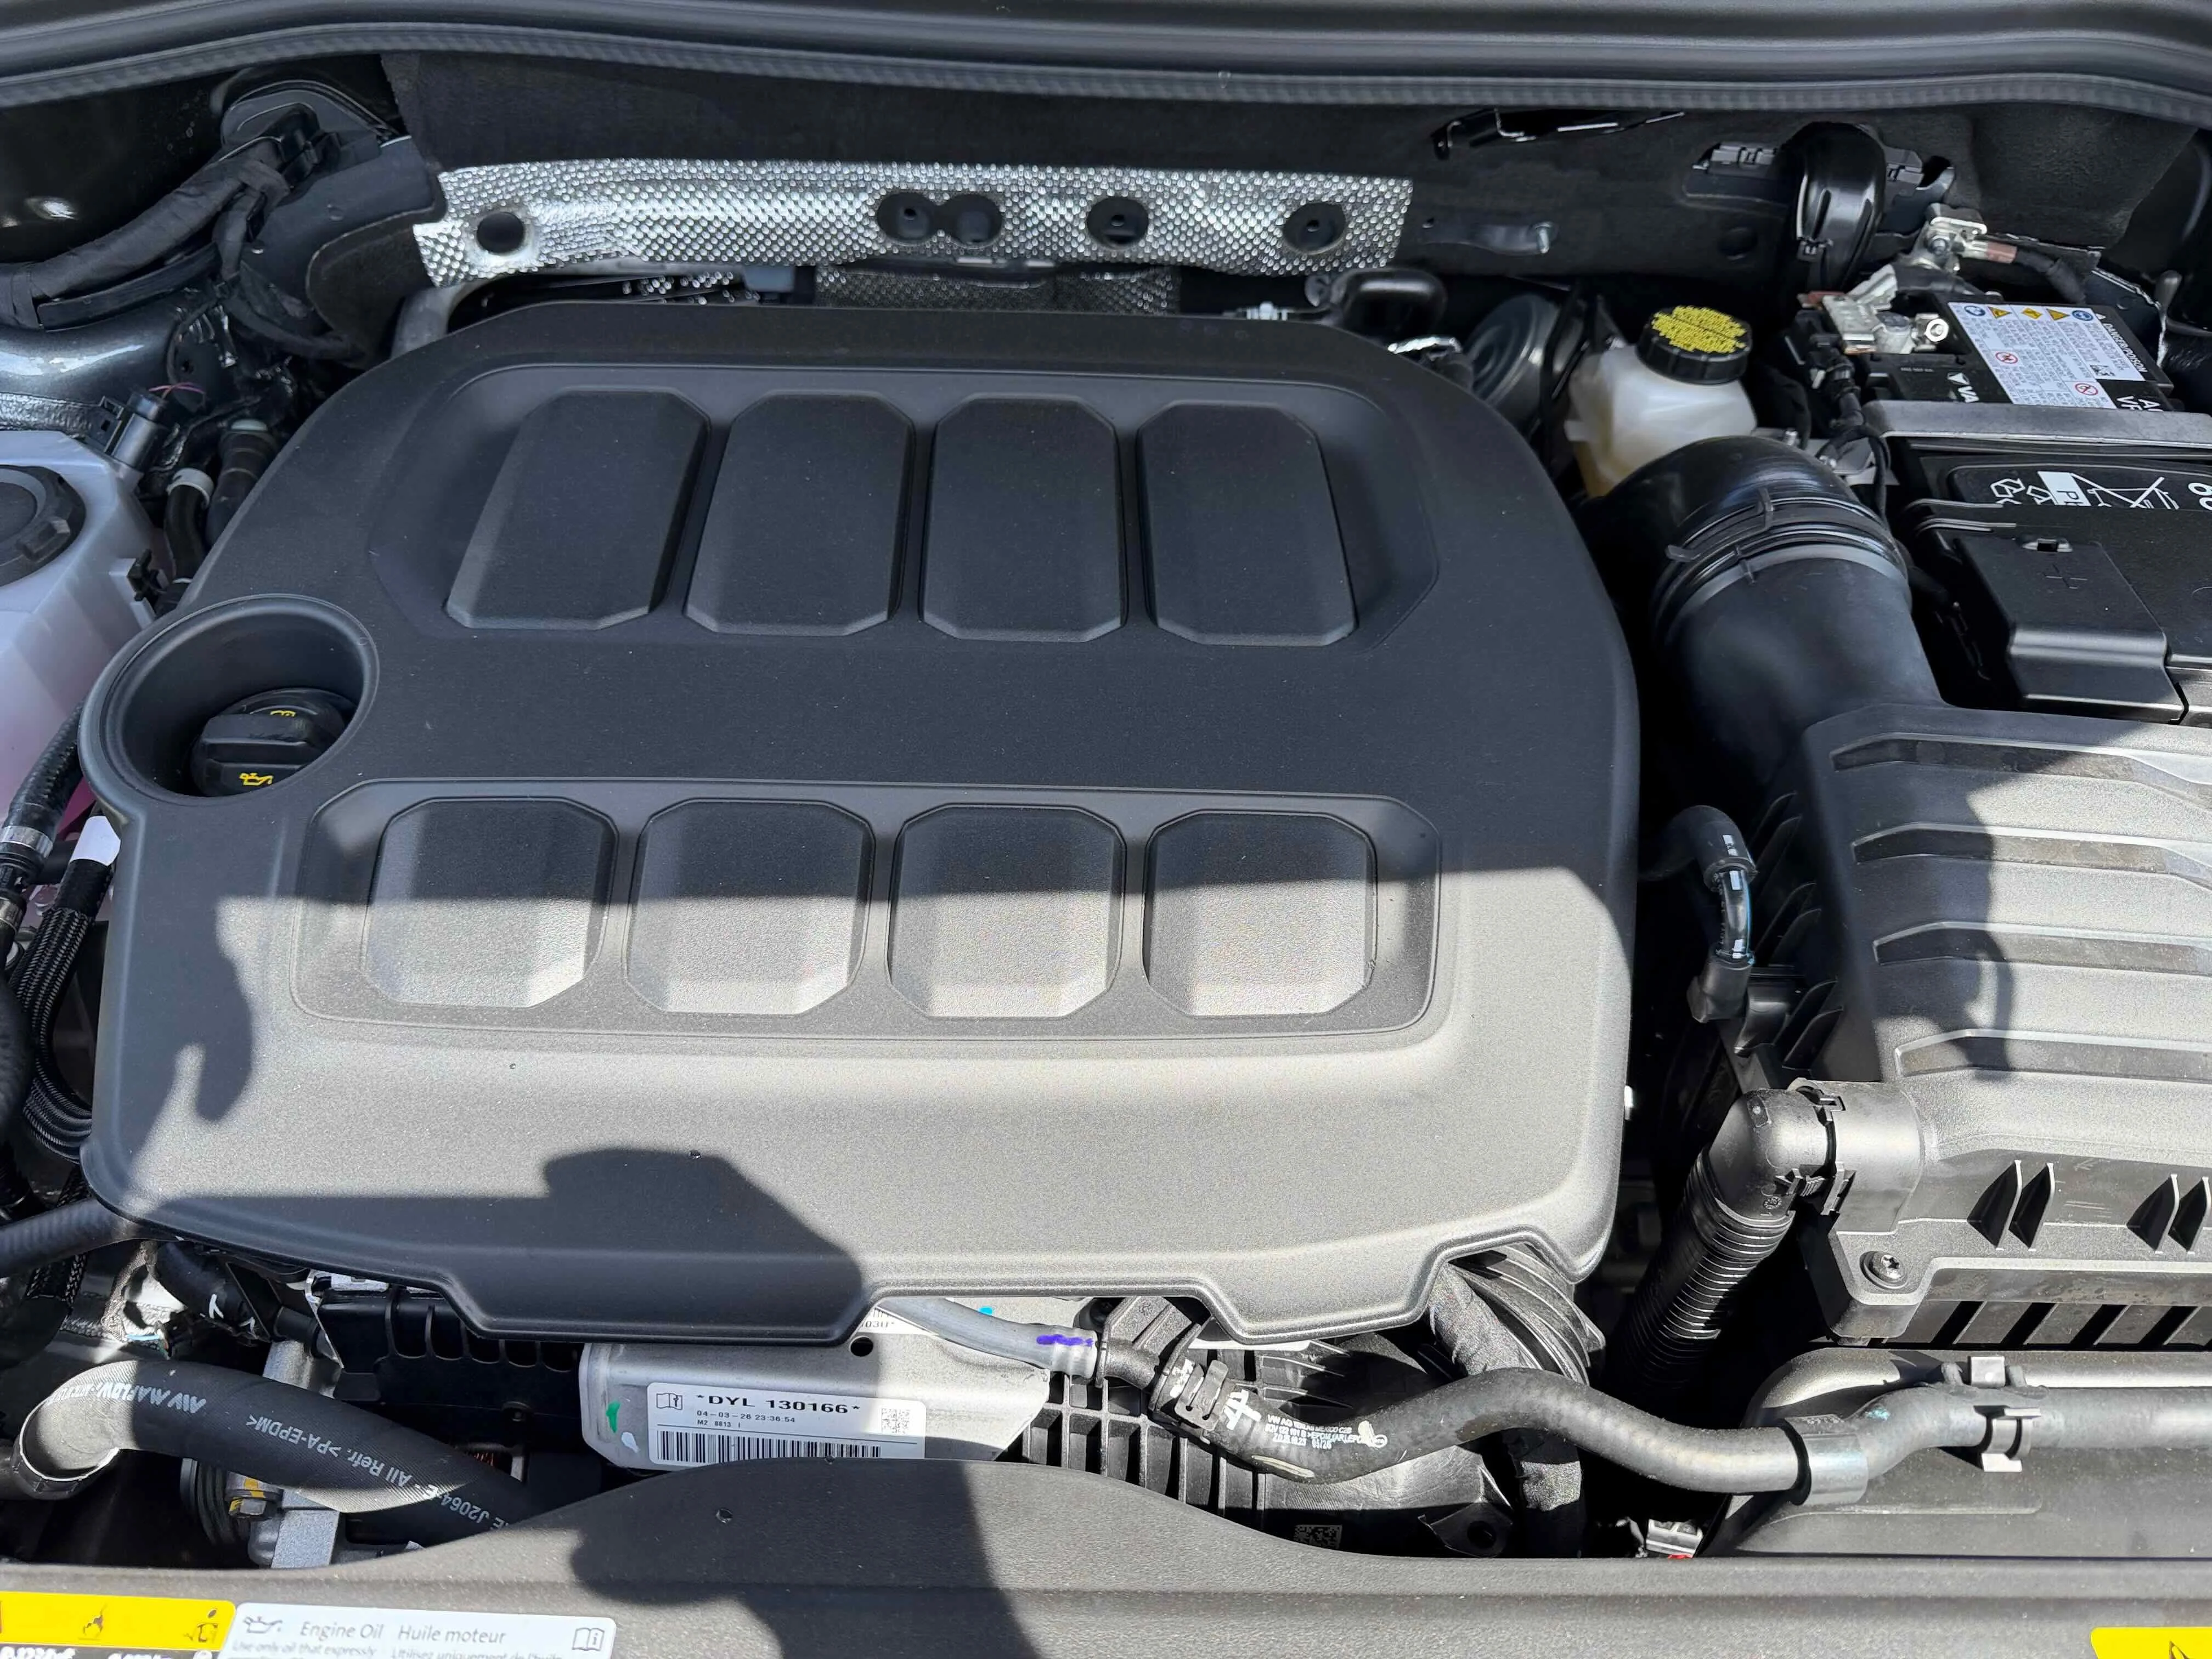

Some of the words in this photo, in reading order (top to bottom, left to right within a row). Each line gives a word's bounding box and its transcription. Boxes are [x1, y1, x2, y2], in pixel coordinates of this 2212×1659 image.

[754, 1413, 795, 1424] 23:36:54
[245, 1414, 342, 1458] >PA-EPDM<
[347, 1448, 385, 1477] Refr.
[385, 1466, 413, 1488] All
[300, 1621, 356, 1642] Engine
[359, 1623, 385, 1639] Oil
[398, 1624, 441, 1641] Huile
[445, 1628, 507, 1645] moteur
